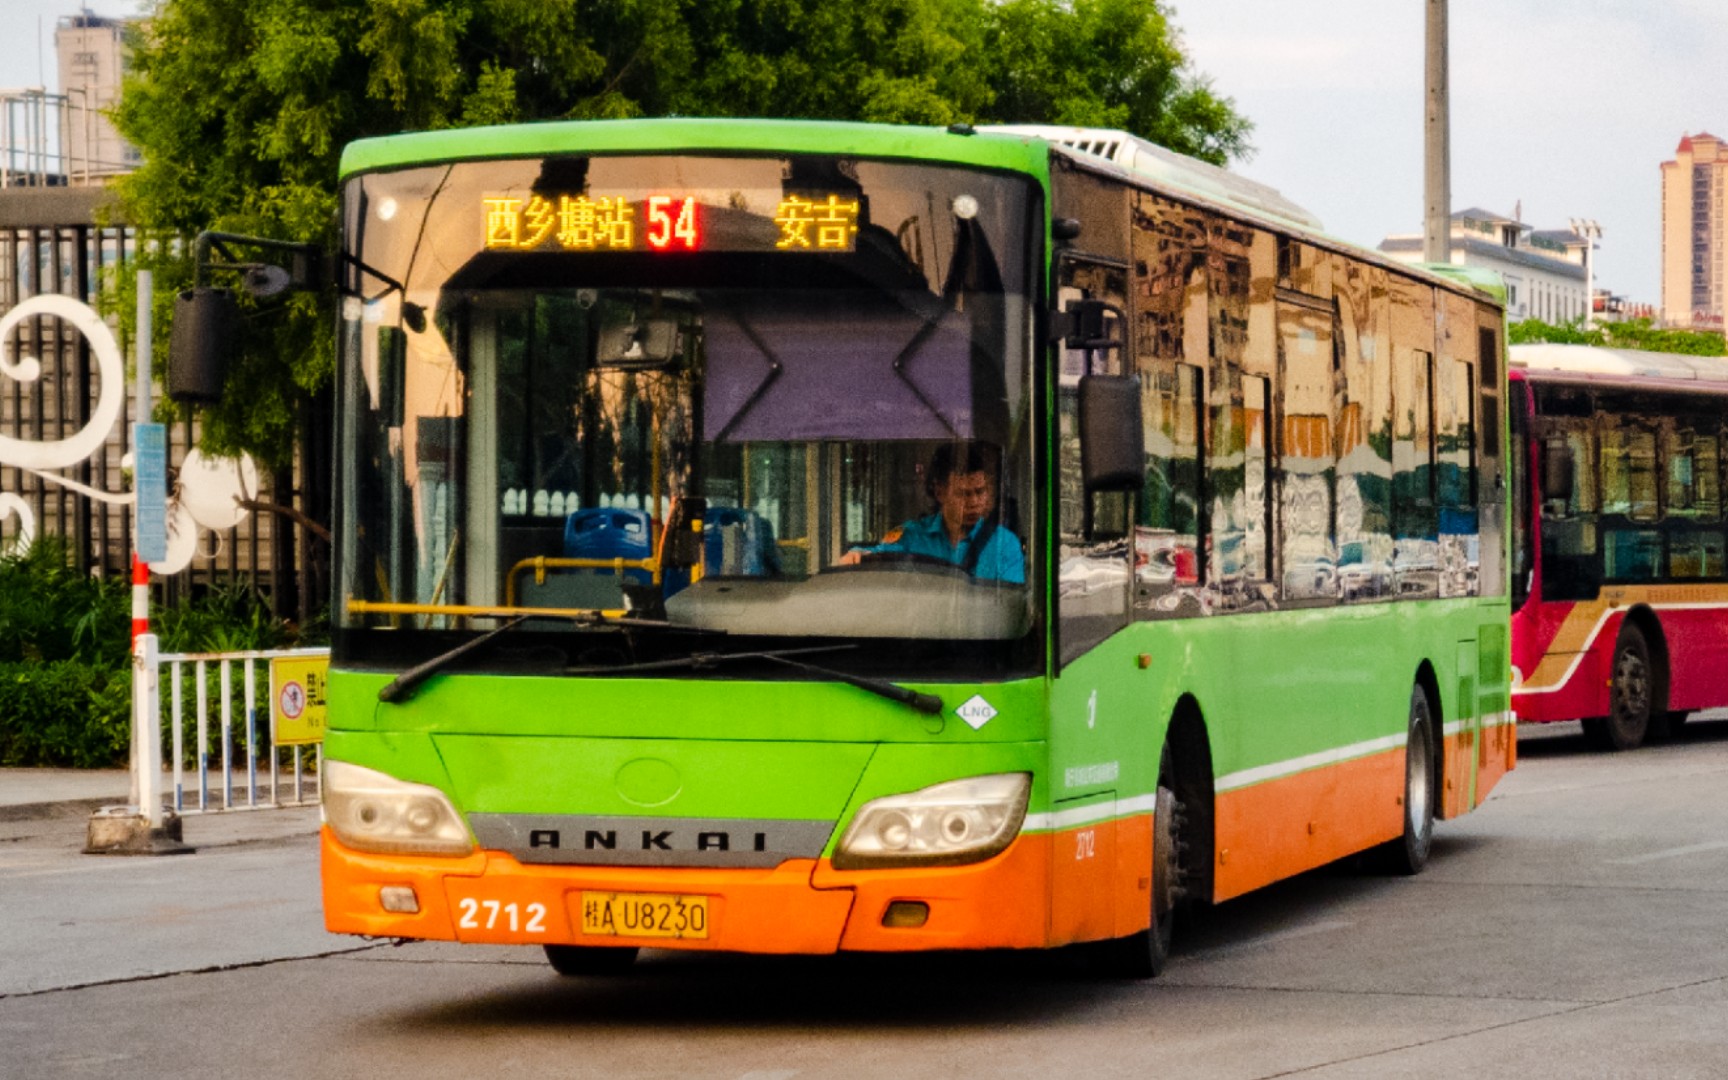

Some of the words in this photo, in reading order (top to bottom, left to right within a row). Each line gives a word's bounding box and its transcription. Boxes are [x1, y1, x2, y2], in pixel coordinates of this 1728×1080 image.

[484, 195, 634, 249] 西乡塘站
[647, 195, 698, 249] 54
[774, 193, 858, 249] 安吉
[962, 706, 991, 718] LNG
[529, 829, 766, 852] ANKAI
[458, 897, 547, 932] 2712
